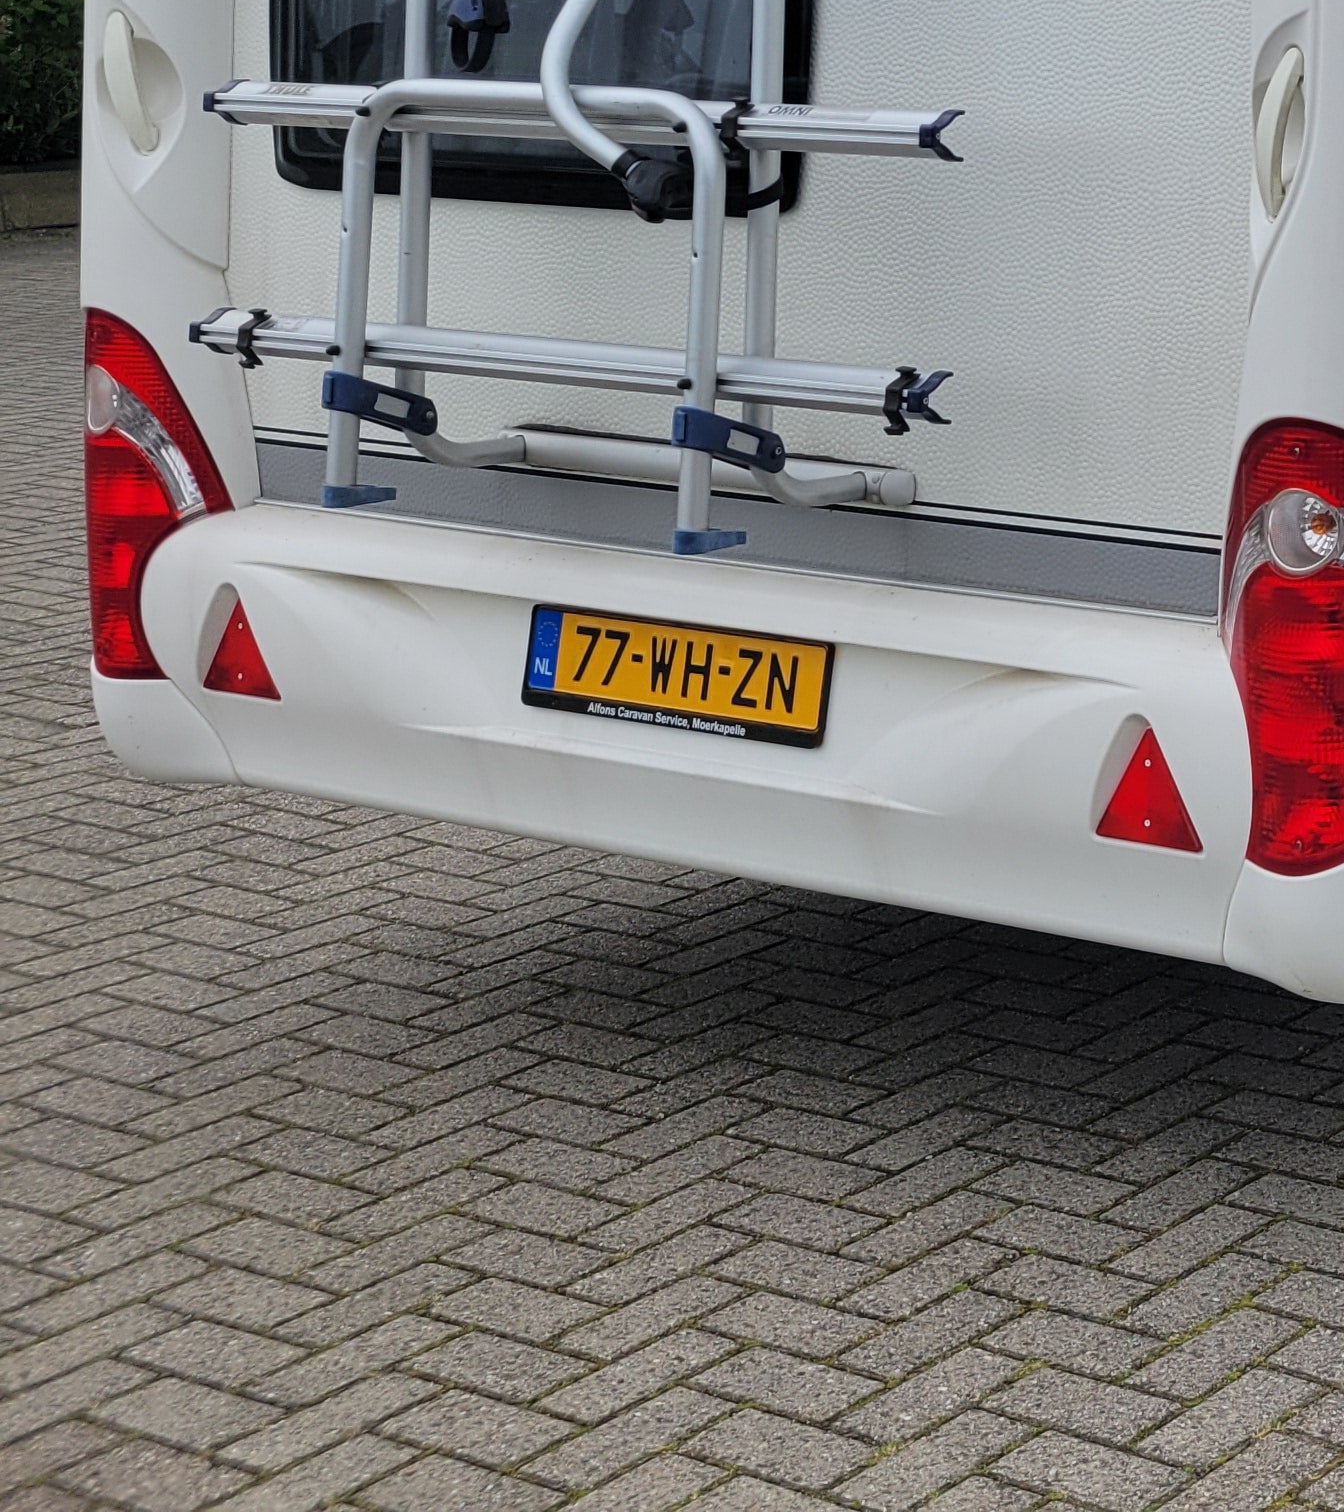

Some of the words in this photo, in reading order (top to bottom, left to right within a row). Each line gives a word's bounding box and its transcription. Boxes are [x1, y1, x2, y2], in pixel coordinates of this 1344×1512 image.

[533, 656, 553, 677] NL
[572, 626, 799, 713] 77-WH-ZN
[587, 701, 617, 717] Alfons
[617, 706, 654, 723] Caravan
[654, 711, 691, 730] Service,
[692, 717, 747, 737] Moerkapelle
